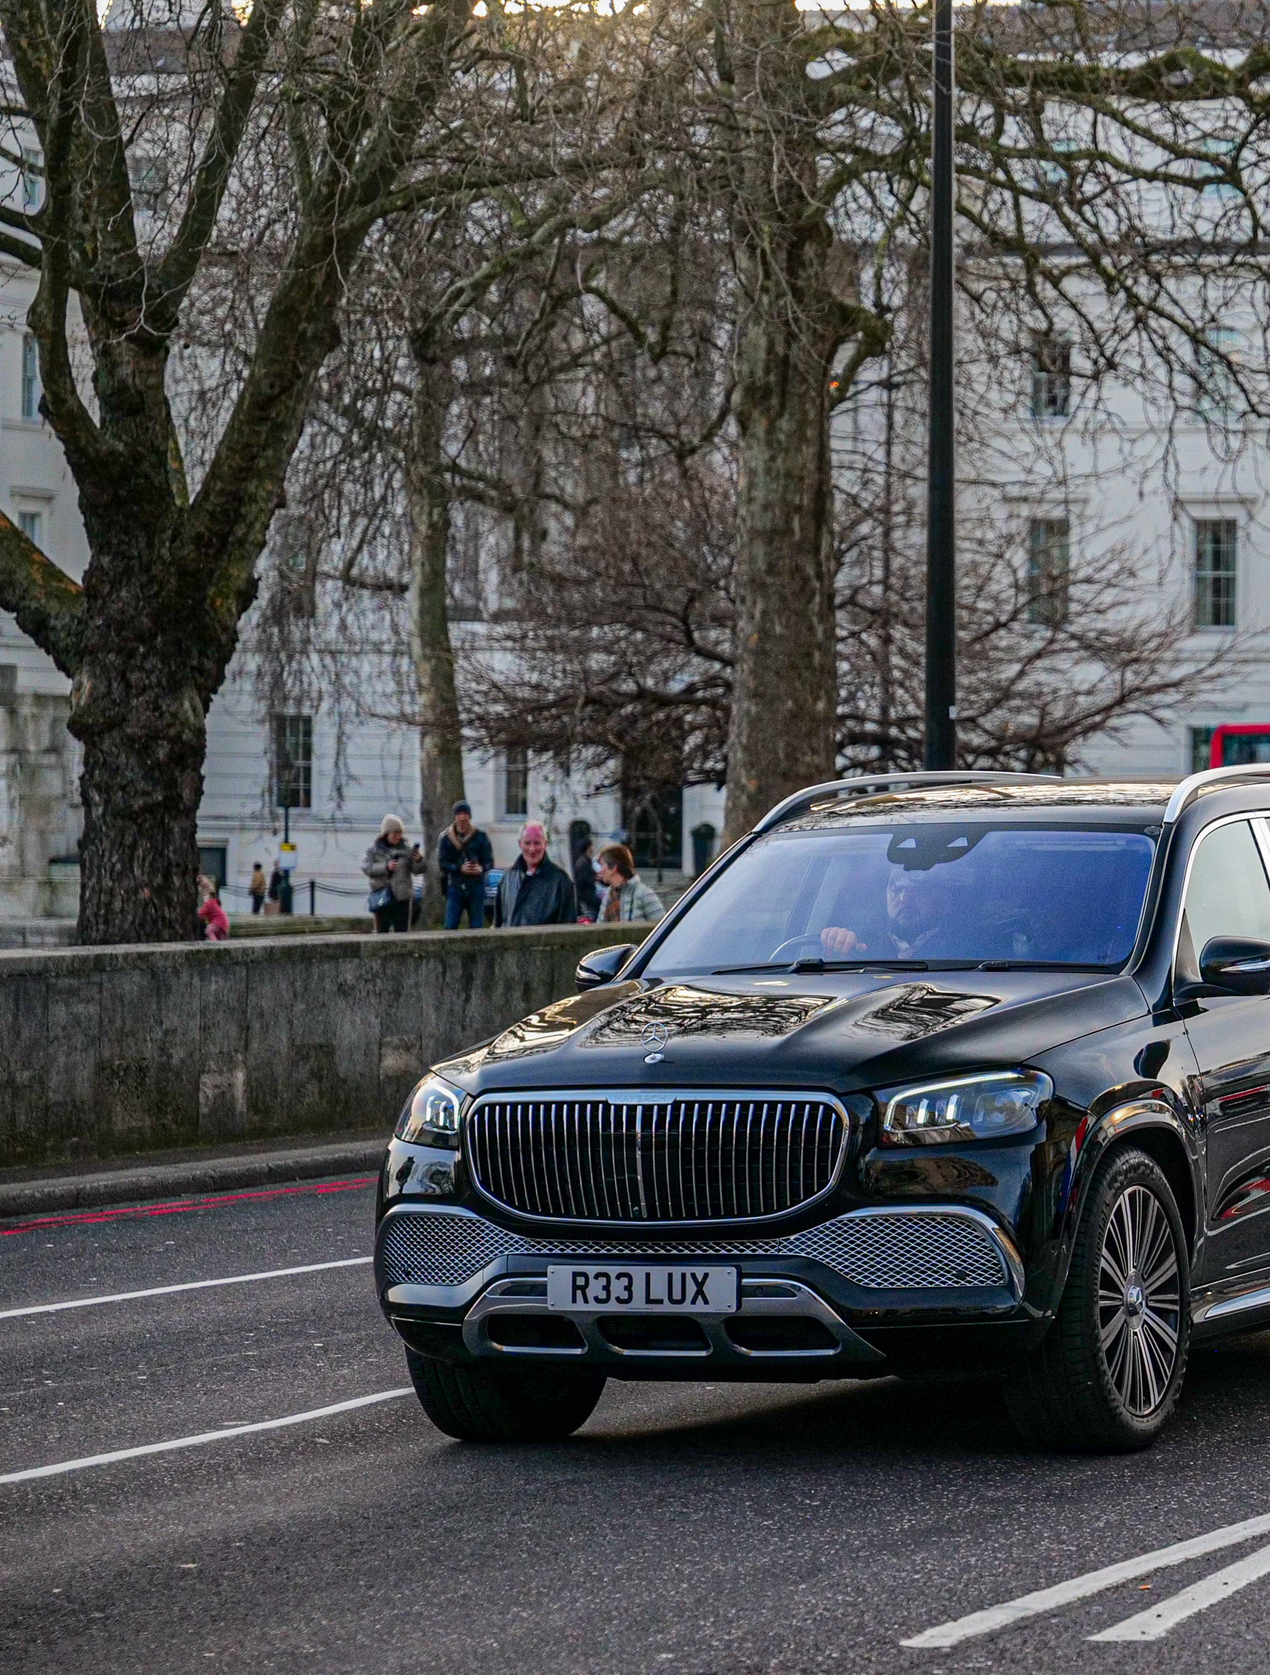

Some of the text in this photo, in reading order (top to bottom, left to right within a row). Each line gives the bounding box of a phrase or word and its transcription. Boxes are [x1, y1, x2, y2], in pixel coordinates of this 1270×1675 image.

[614, 1093, 667, 1102] MAYBACH
[571, 1271, 710, 1305] R33 LUX
